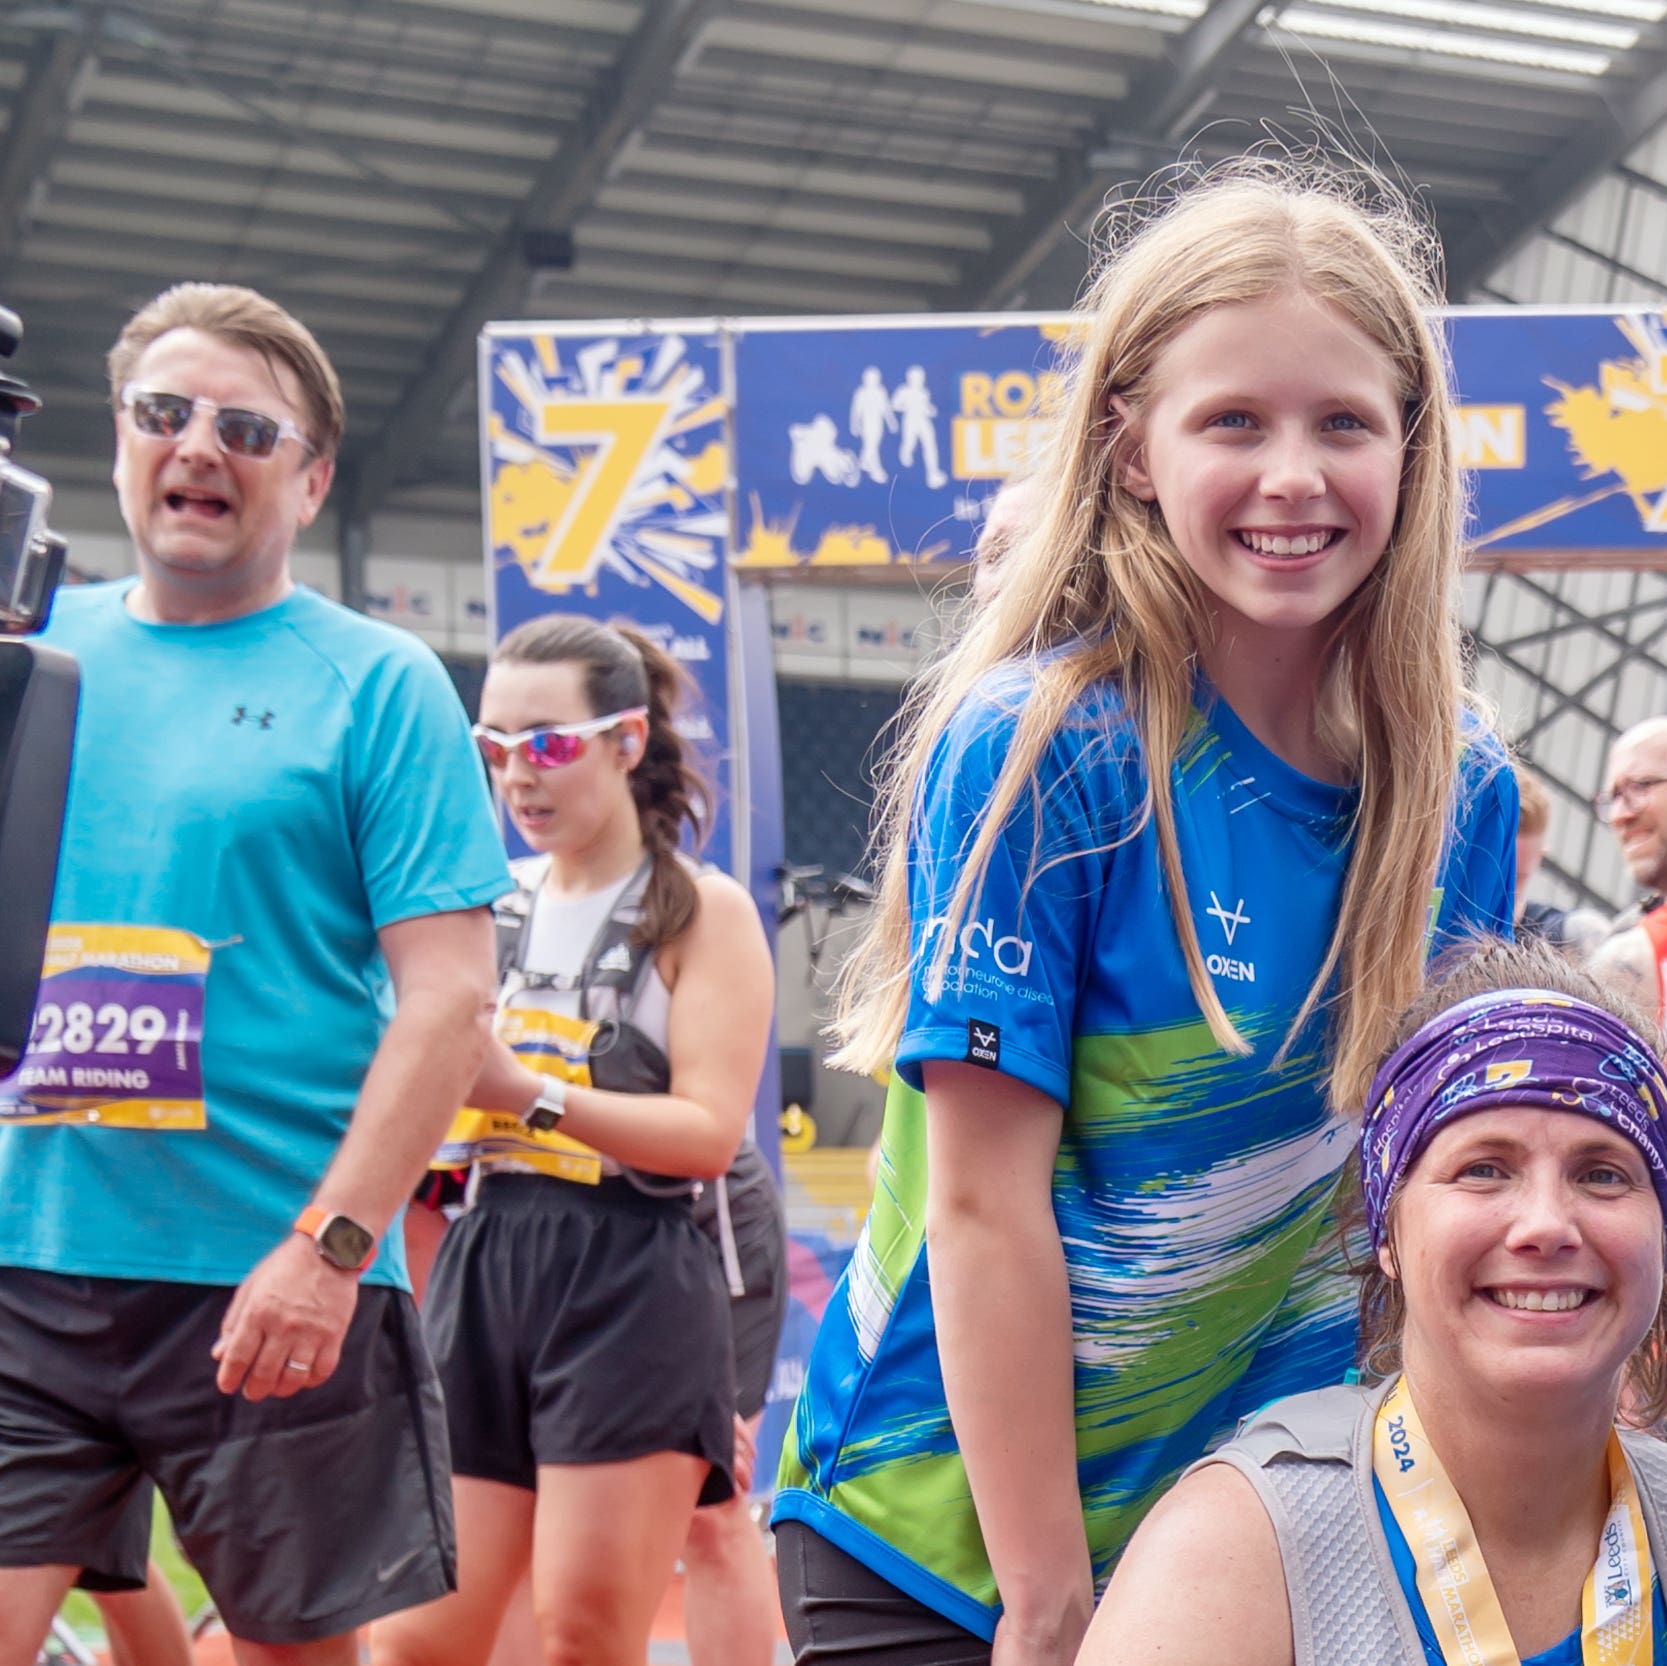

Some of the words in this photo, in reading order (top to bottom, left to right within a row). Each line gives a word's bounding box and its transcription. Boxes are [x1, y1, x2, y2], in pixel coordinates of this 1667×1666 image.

[533, 395, 675, 584] 7
[1206, 954, 1255, 982] OXEN
[1018, 986, 1055, 1006] disea
[28, 1001, 167, 1055] 2829
[972, 1047, 997, 1062] OXEN
[72, 1067, 150, 1089] RIDING
[1388, 1415, 1415, 1473] 2024
[1605, 1523, 1623, 1579] Leeds
